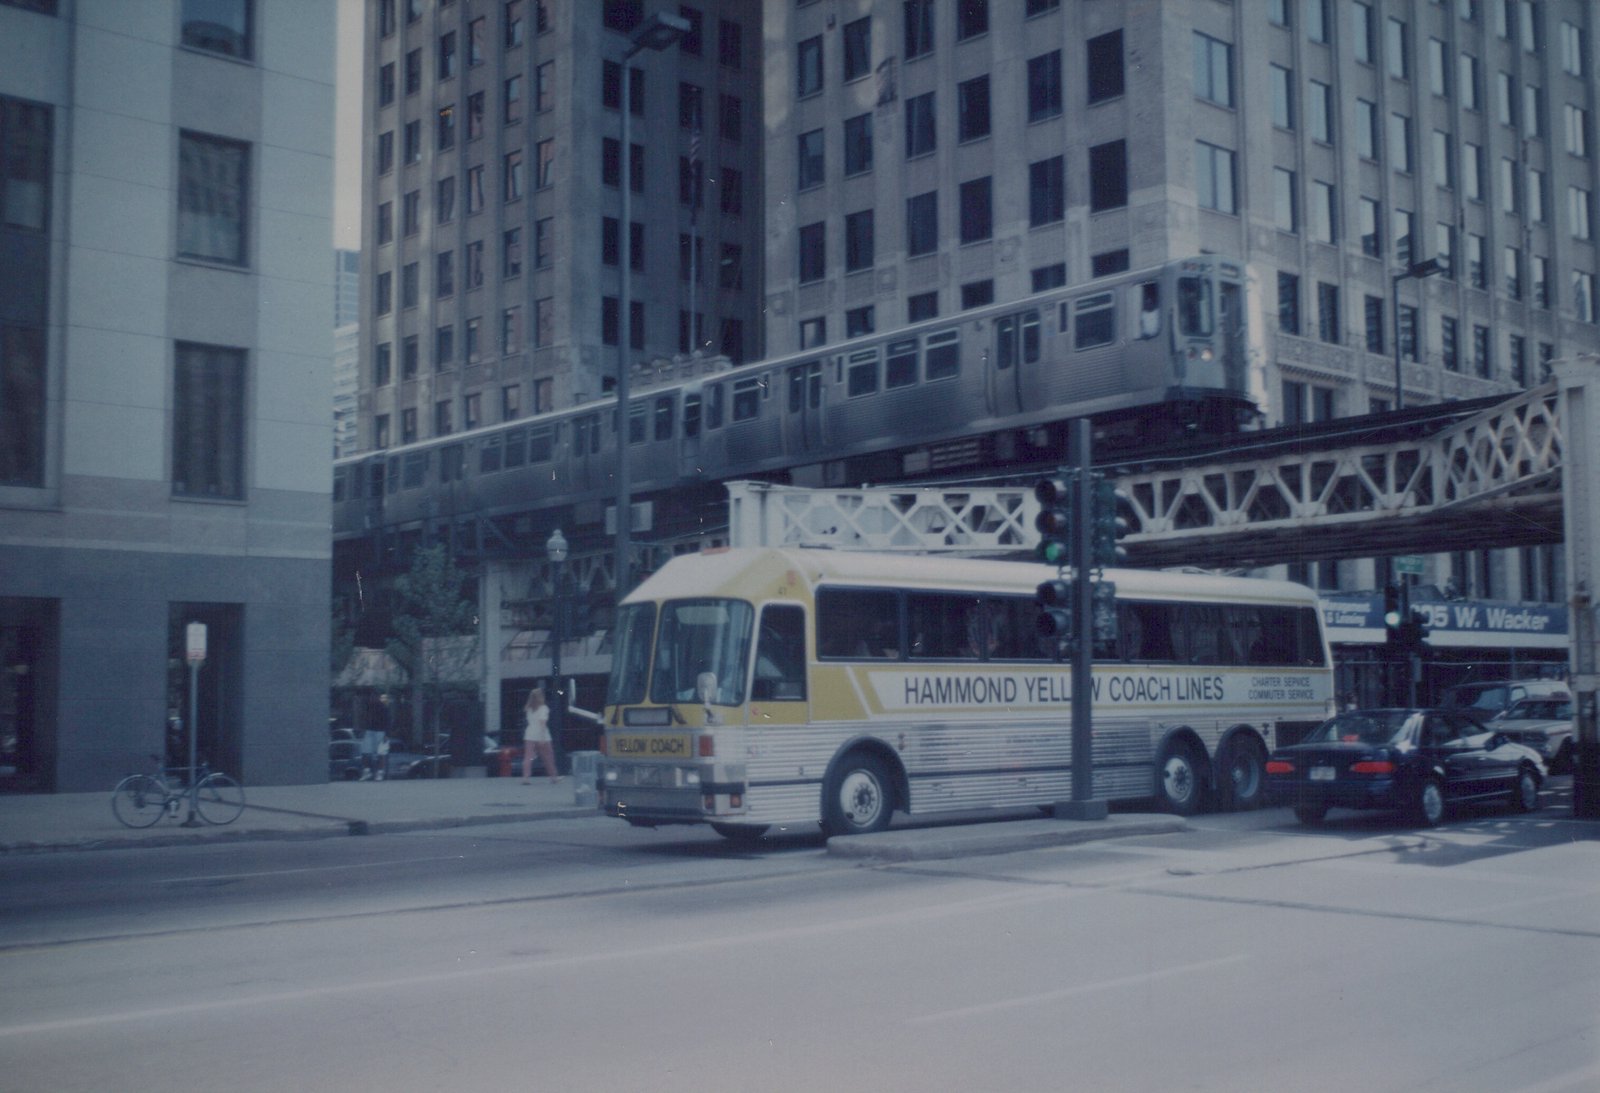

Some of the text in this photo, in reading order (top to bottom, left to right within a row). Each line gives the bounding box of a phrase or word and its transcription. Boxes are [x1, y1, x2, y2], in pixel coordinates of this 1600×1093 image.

[1454, 605, 1480, 629] W.
[1486, 607, 1550, 631] Wacker
[905, 674, 1225, 704] HAMMOND YELLW COACH LINES
[1251, 676, 1311, 688] CHARTER SERVICE
[1247, 688, 1315, 700] COMMUTER SERVICE
[615, 738, 684, 753] YELLOW COACH
